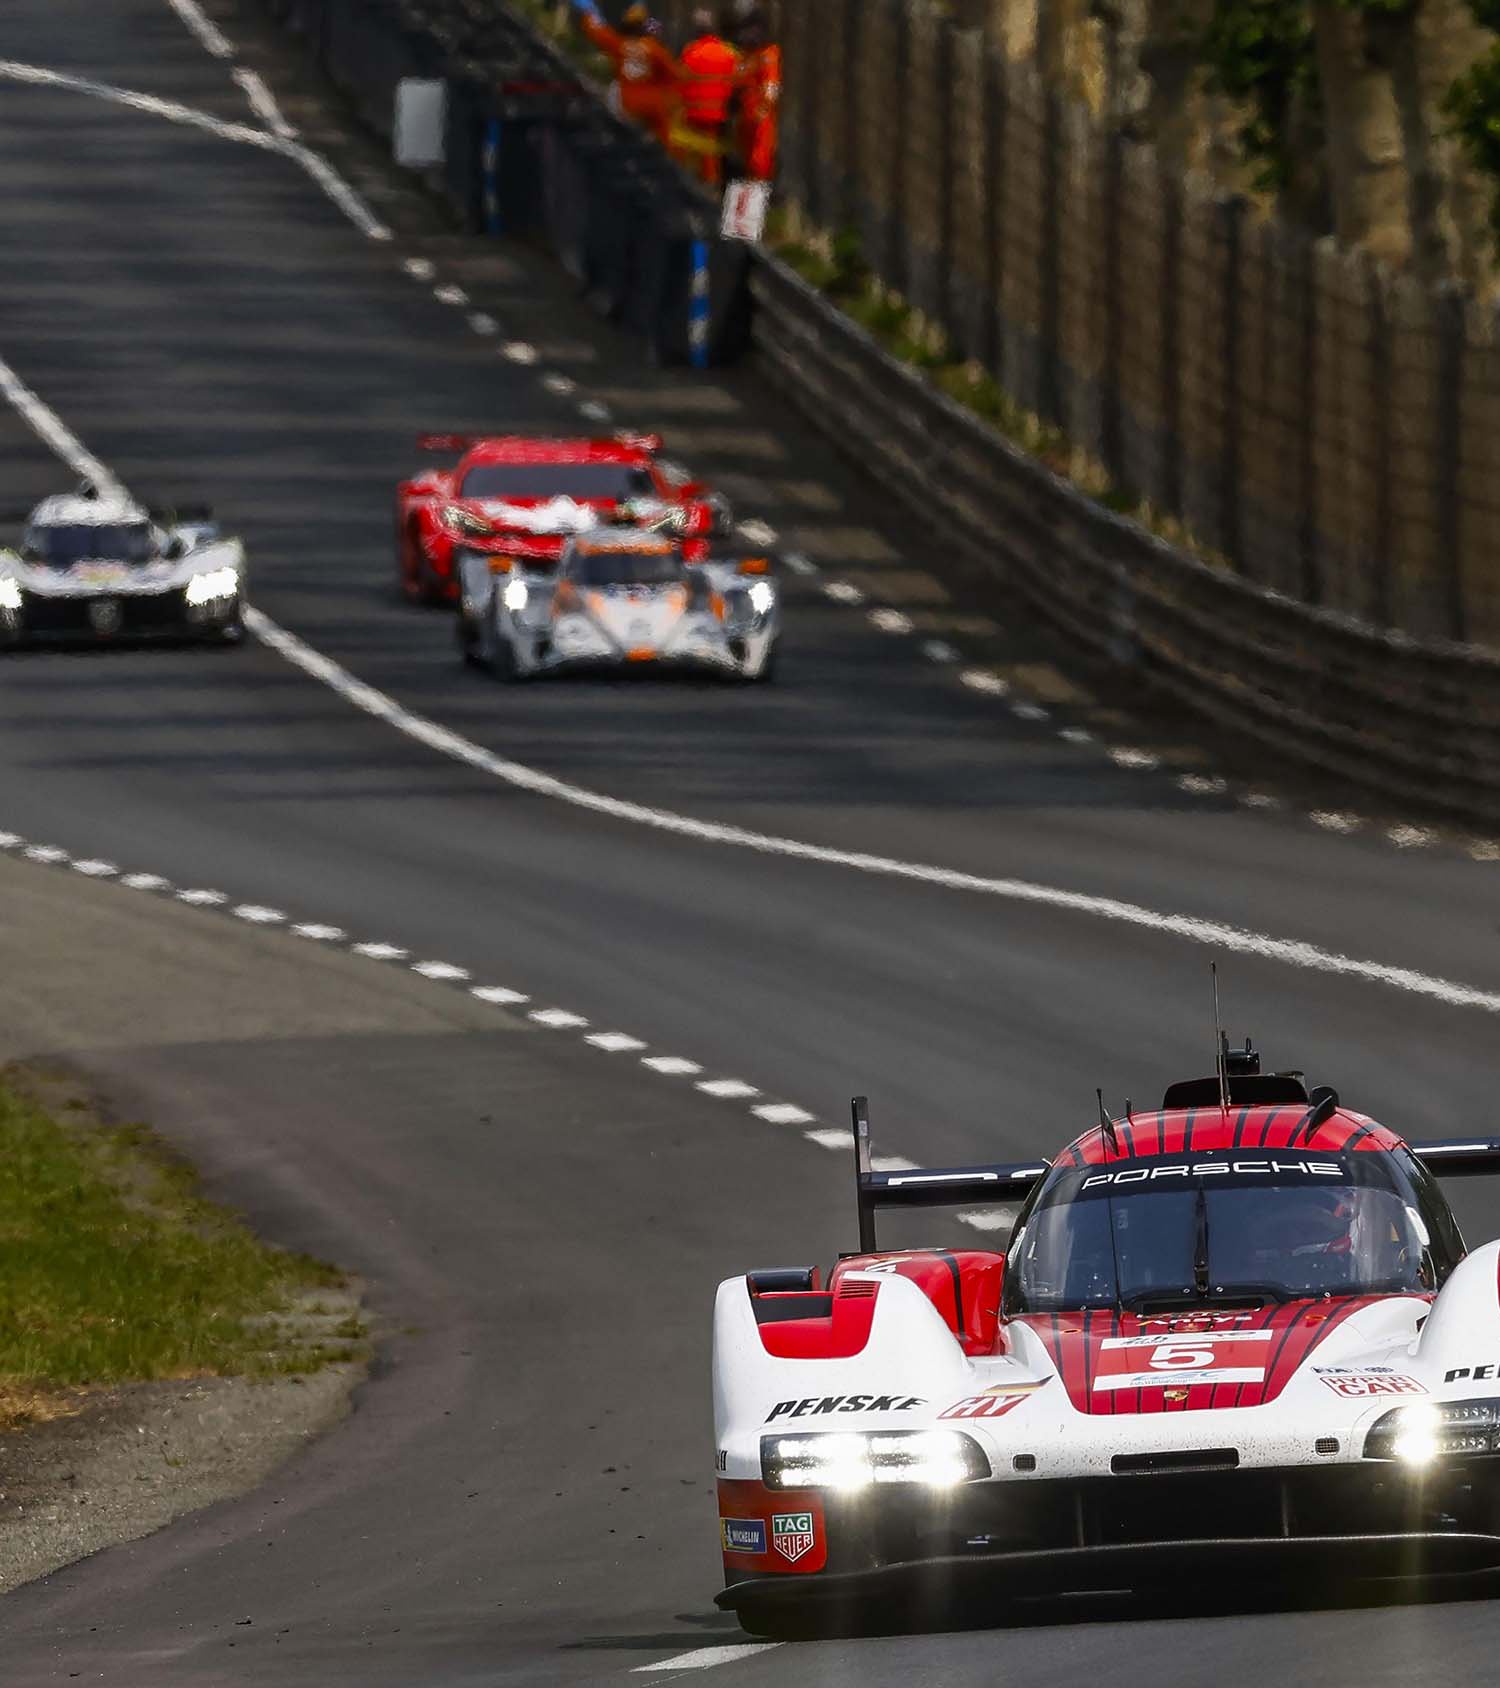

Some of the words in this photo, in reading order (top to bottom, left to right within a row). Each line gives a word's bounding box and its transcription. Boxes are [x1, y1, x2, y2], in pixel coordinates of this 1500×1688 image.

[1081, 1160, 1344, 1191] PORSCHE
[1148, 1342, 1215, 1370] 5
[1339, 1382, 1419, 1396] CAR
[764, 1395, 929, 1424] PENSKE
[775, 1517, 809, 1532] TAG
[775, 1535, 811, 1558] HEUER
